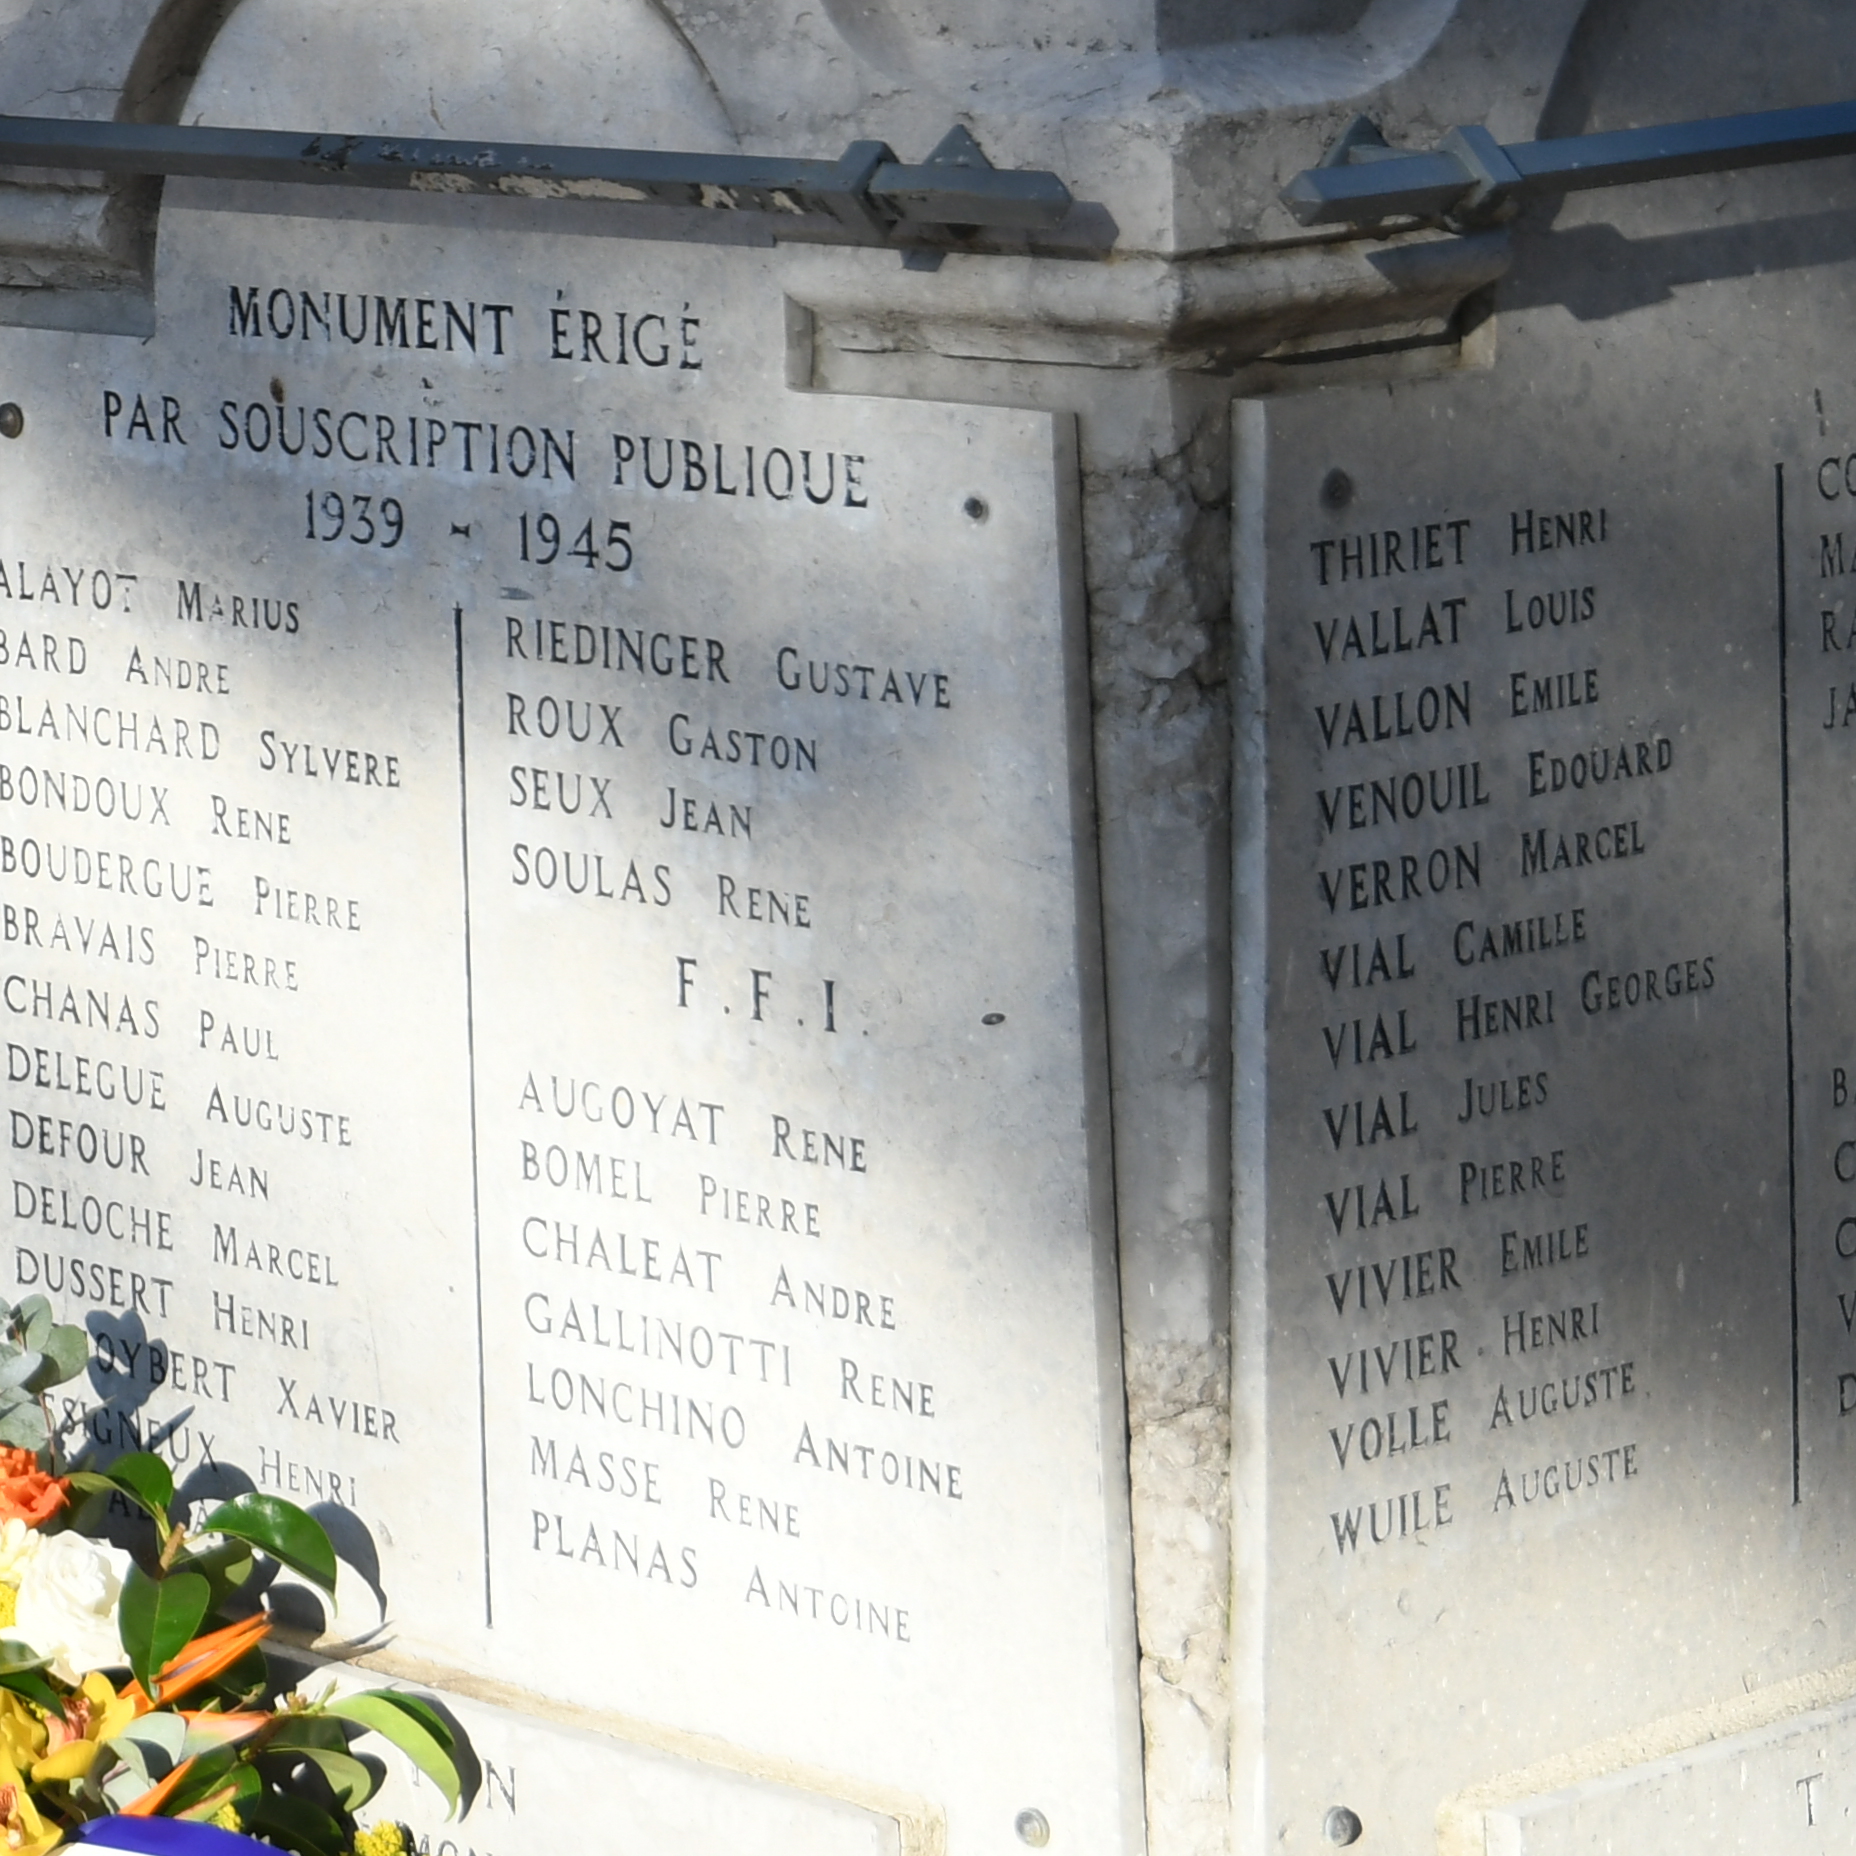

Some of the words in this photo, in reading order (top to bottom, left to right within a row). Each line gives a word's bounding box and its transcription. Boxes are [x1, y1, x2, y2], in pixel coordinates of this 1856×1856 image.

[230, 286, 513, 355] MONUMENT
[551, 290, 702, 369] ÉRIGÉ
[104, 391, 186, 444] PAR
[220, 401, 575, 481] SOUSCRIPTION
[614, 435, 867, 508] PUBLIQUE
[306, 490, 403, 548] 1939
[520, 513, 632, 572] 1945
[1310, 520, 1470, 585] THIRIET
[1511, 508, 1606, 556] HENRI
[178, 581, 299, 634] MARIUS
[1314, 598, 1466, 663] VALLAT
[1505, 587, 1595, 634] LOUIS
[126, 646, 229, 694] ANDRE
[506, 617, 730, 683] RIEDINGER
[777, 647, 951, 709] GUSTAVE
[507, 693, 623, 747] ROUX
[669, 713, 816, 772] GASTON
[1316, 681, 1470, 749] VALLON
[1511, 669, 1599, 717] EMILE
[260, 730, 400, 787] SYLVERE
[510, 766, 612, 819] SEUX
[660, 788, 751, 838] JEAN
[1316, 762, 1489, 833] VENOUIL
[1528, 738, 1672, 797] EDOUARD
[211, 795, 290, 844] RENE
[1, 836, 213, 907] BOUDERGUE
[255, 876, 360, 931] PIERRE
[513, 843, 671, 906] SOULAS
[718, 874, 810, 928] RENE
[1319, 842, 1480, 914] VERRON
[1522, 821, 1645, 877] MARCEL
[4, 904, 154, 965] BRAVAIS
[194, 935, 298, 991] PIERRE
[1320, 934, 1414, 991] VIAL
[1454, 908, 1586, 966] CAMILLE
[4, 975, 159, 1038] CHANAS
[200, 1010, 278, 1060] PAUL
[1322, 1010, 1416, 1069] VIAL
[1457, 991, 1554, 1043] HENRI
[1581, 956, 1714, 1015] GEORGES
[7, 1043, 165, 1111] DELEGUE
[207, 1084, 351, 1146] AUGUSTE
[519, 1072, 724, 1145] AUGOYAT
[772, 1115, 866, 1173] RENE
[1323, 1091, 1417, 1150] VIAL
[1458, 1072, 1547, 1124] JULES
[10, 1110, 149, 1176] DEFOUR
[190, 1149, 268, 1200] JEAN
[521, 1140, 651, 1203] BOMEL
[700, 1174, 820, 1238] PIERRE
[1324, 1175, 1419, 1236] VIAL
[1460, 1150, 1564, 1207] PIERRE
[13, 1180, 173, 1251] DELOCHE
[214, 1223, 338, 1286] MARCEL
[523, 1217, 721, 1292] CHALEAT
[771, 1265, 895, 1330] ANDRE
[1326, 1248, 1461, 1315] VIVIER
[1501, 1224, 1588, 1278] EMILE
[17, 1247, 173, 1322] DUSSERT
[213, 1291, 308, 1350] HENRI
[525, 1292, 790, 1392] GALLINOTTI
[841, 1358, 934, 1418] RENE
[1328, 1330, 1461, 1399] VIVIER
[1504, 1303, 1598, 1356] HENRI
[277, 1377, 399, 1443] XAVIER
[528, 1363, 745, 1449] LONCHINO
[794, 1422, 962, 1500] ANTOINE
[1329, 1399, 1450, 1470] VOLLE
[1489, 1362, 1635, 1430] AUGUSTE
[259, 1446, 355, 1513] HENRI
[532, 1436, 661, 1504] MASSE
[709, 1478, 800, 1538] RENE
[1330, 1484, 1452, 1555] WUILE
[1494, 1444, 1638, 1512] AUGUSTE
[532, 1510, 697, 1588] PLANAS
[746, 1565, 910, 1643] ANTOINE
